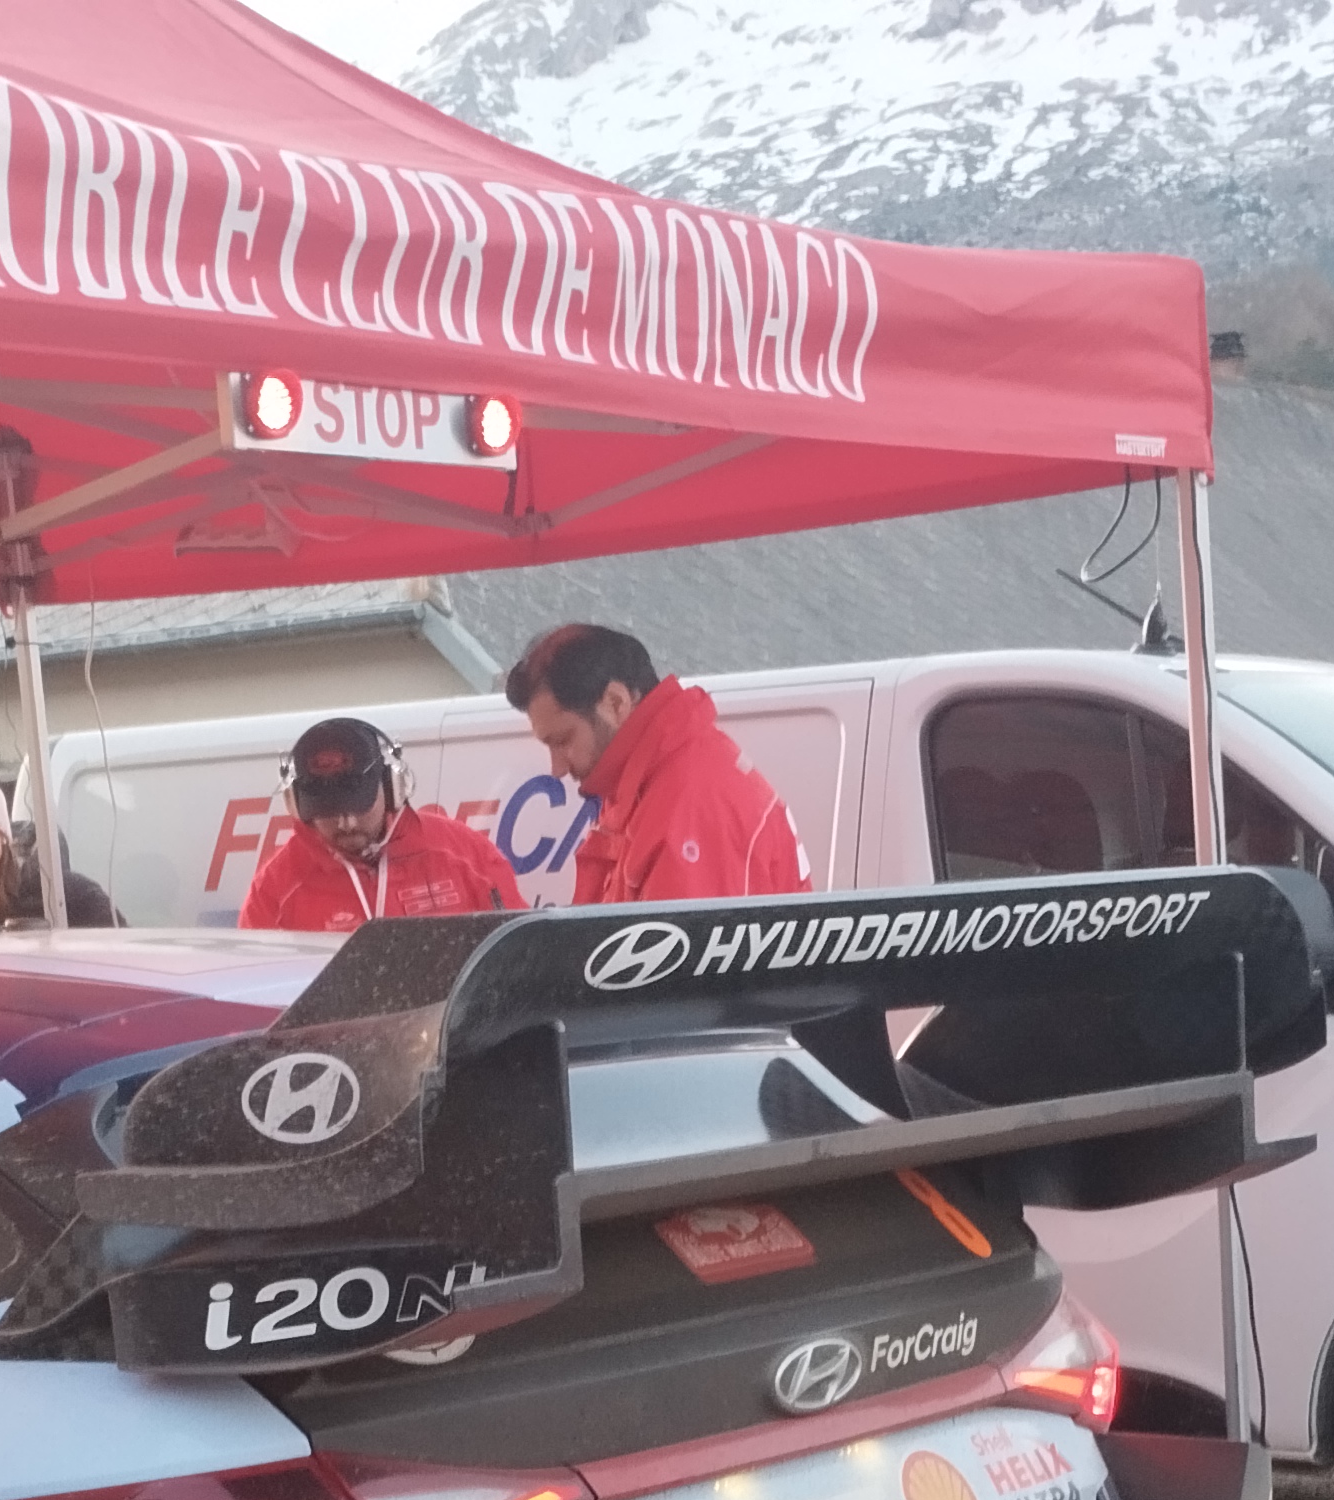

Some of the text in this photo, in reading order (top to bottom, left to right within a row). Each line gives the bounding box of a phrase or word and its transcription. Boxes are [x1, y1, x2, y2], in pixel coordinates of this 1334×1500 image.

[278, 148, 485, 346] CLUB
[481, 181, 599, 366] DE
[596, 196, 880, 404] MONACO
[312, 376, 442, 450] STOP
[869, 1310, 979, 1373] ForCraig
[971, 1424, 1014, 1457] Shell
[984, 1442, 1074, 1497] HELIX
